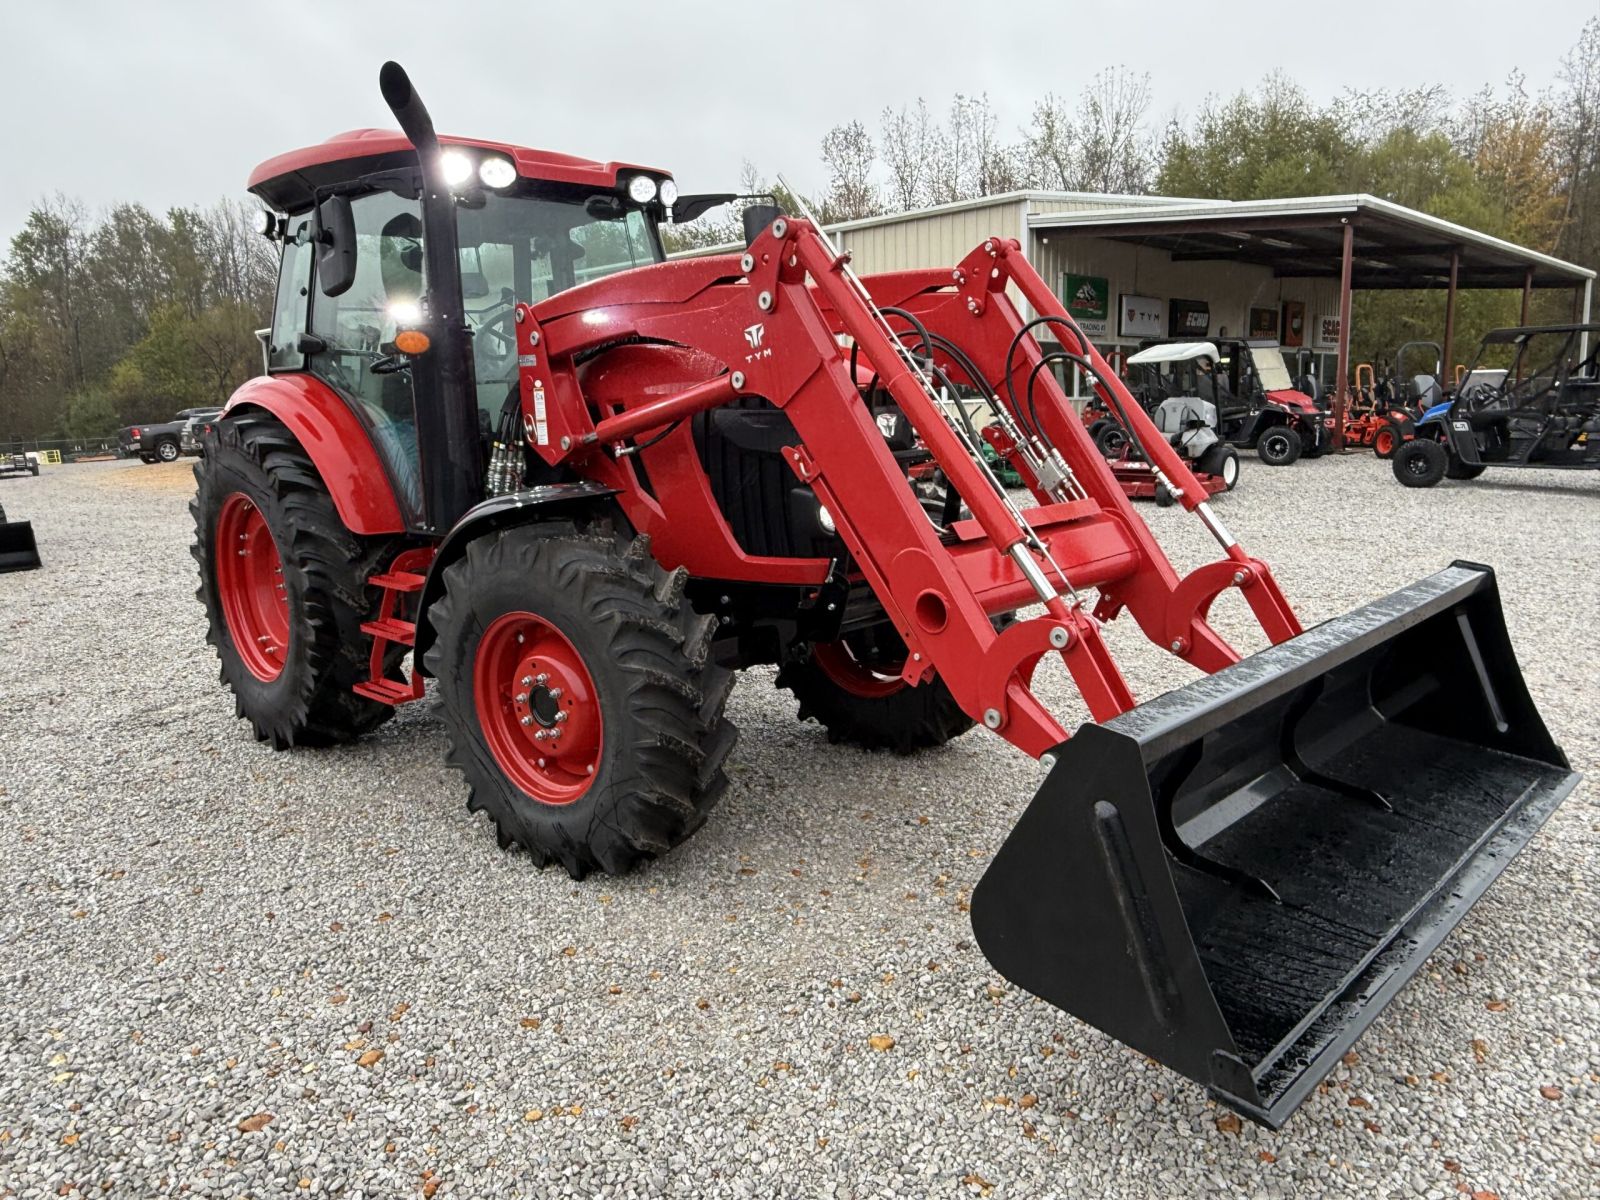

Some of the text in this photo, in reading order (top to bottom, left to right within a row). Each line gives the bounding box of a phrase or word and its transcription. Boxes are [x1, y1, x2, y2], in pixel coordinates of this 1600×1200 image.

[1139, 312, 1160, 321] TYM
[1186, 312, 1209, 328] ECHO
[745, 348, 772, 364] TYM
